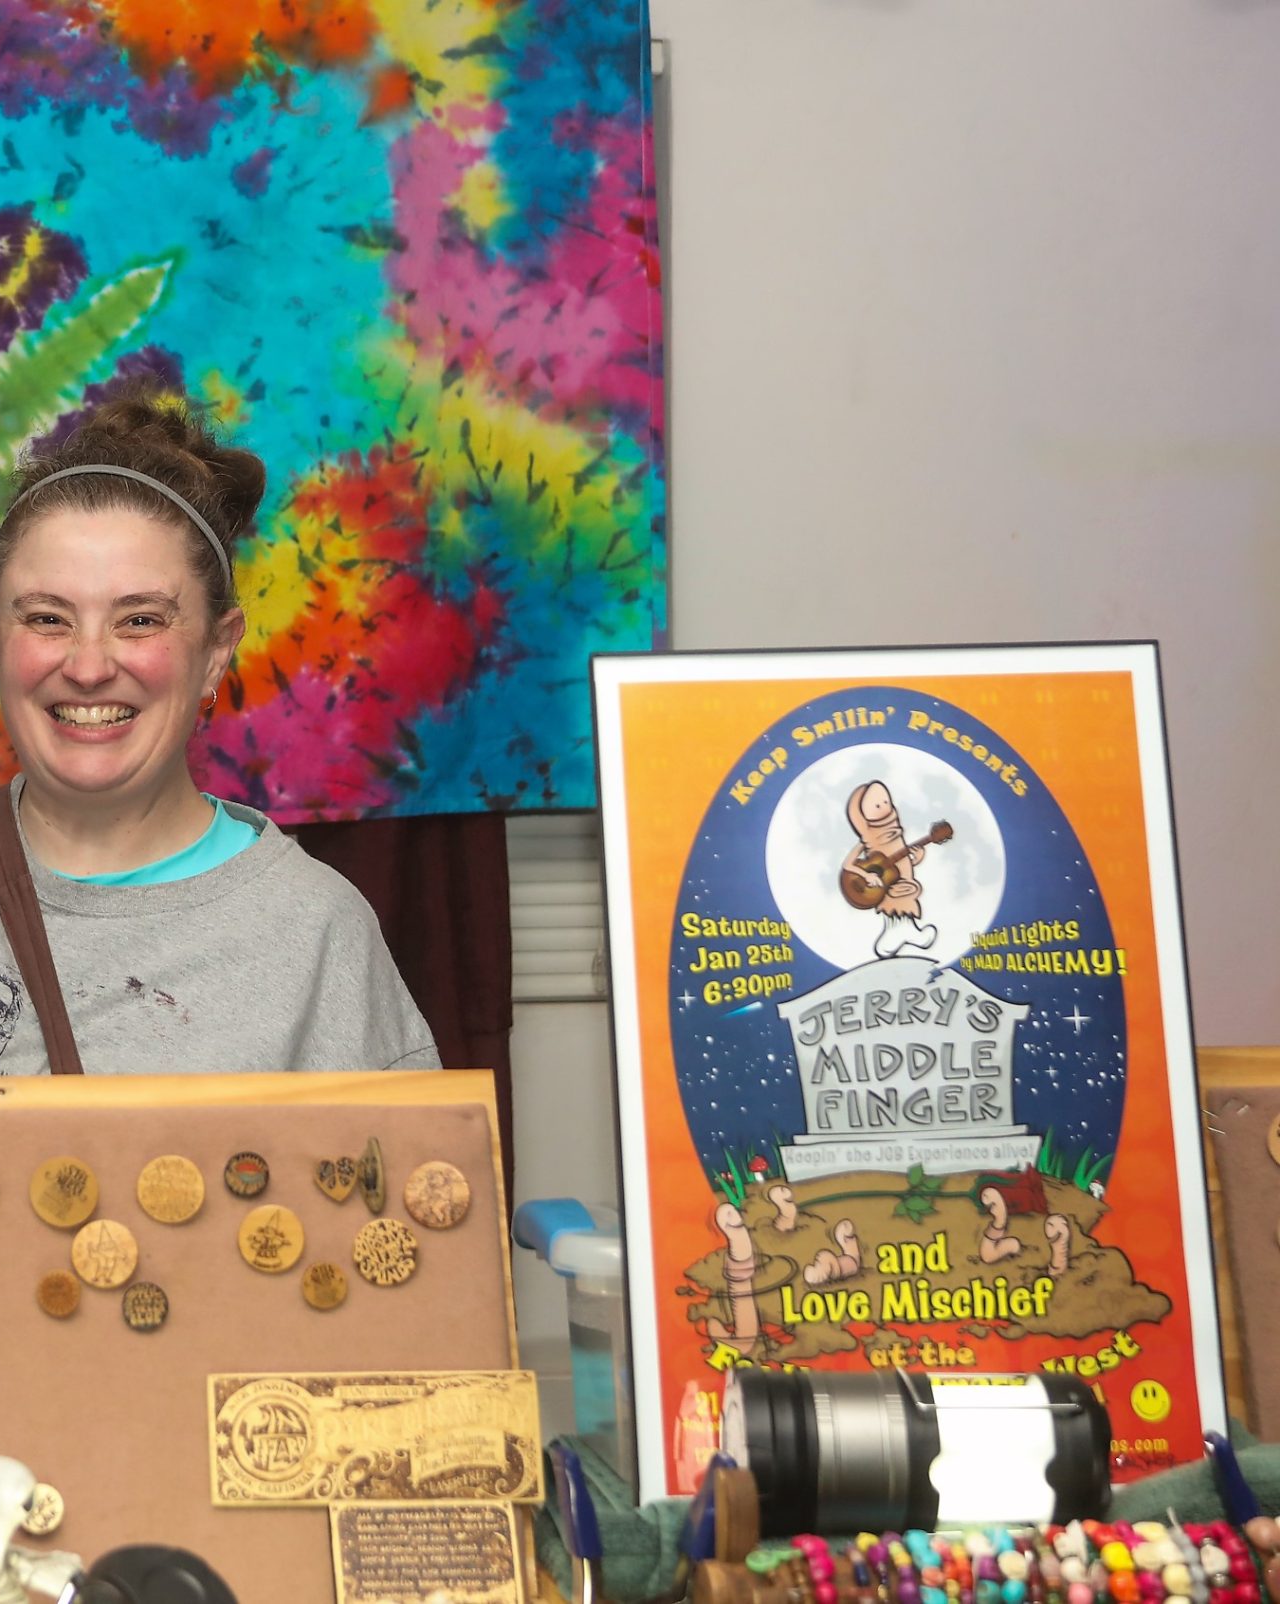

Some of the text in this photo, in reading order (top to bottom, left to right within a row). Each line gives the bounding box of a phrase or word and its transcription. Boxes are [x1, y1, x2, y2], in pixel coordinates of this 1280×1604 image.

[729, 706, 1028, 806] Keep Smilin' Presents
[681, 912, 792, 941] Saturday
[970, 920, 1081, 950] Liquid Lights
[689, 943, 793, 973] Jan 25th
[974, 952, 1004, 971] MAD
[1006, 949, 1129, 976] ALCHEMY!
[703, 972, 792, 1005] 6:30pm
[797, 986, 1004, 1047] JERRY'S
[811, 1040, 1001, 1085] MIDDLE
[816, 1082, 1003, 1129] FINGER
[846, 1149, 871, 1163] the
[909, 1144, 989, 1165] Experience
[877, 1231, 951, 1275] and
[780, 1276, 1055, 1324] Love Mischief
[870, 1340, 976, 1367] at the
